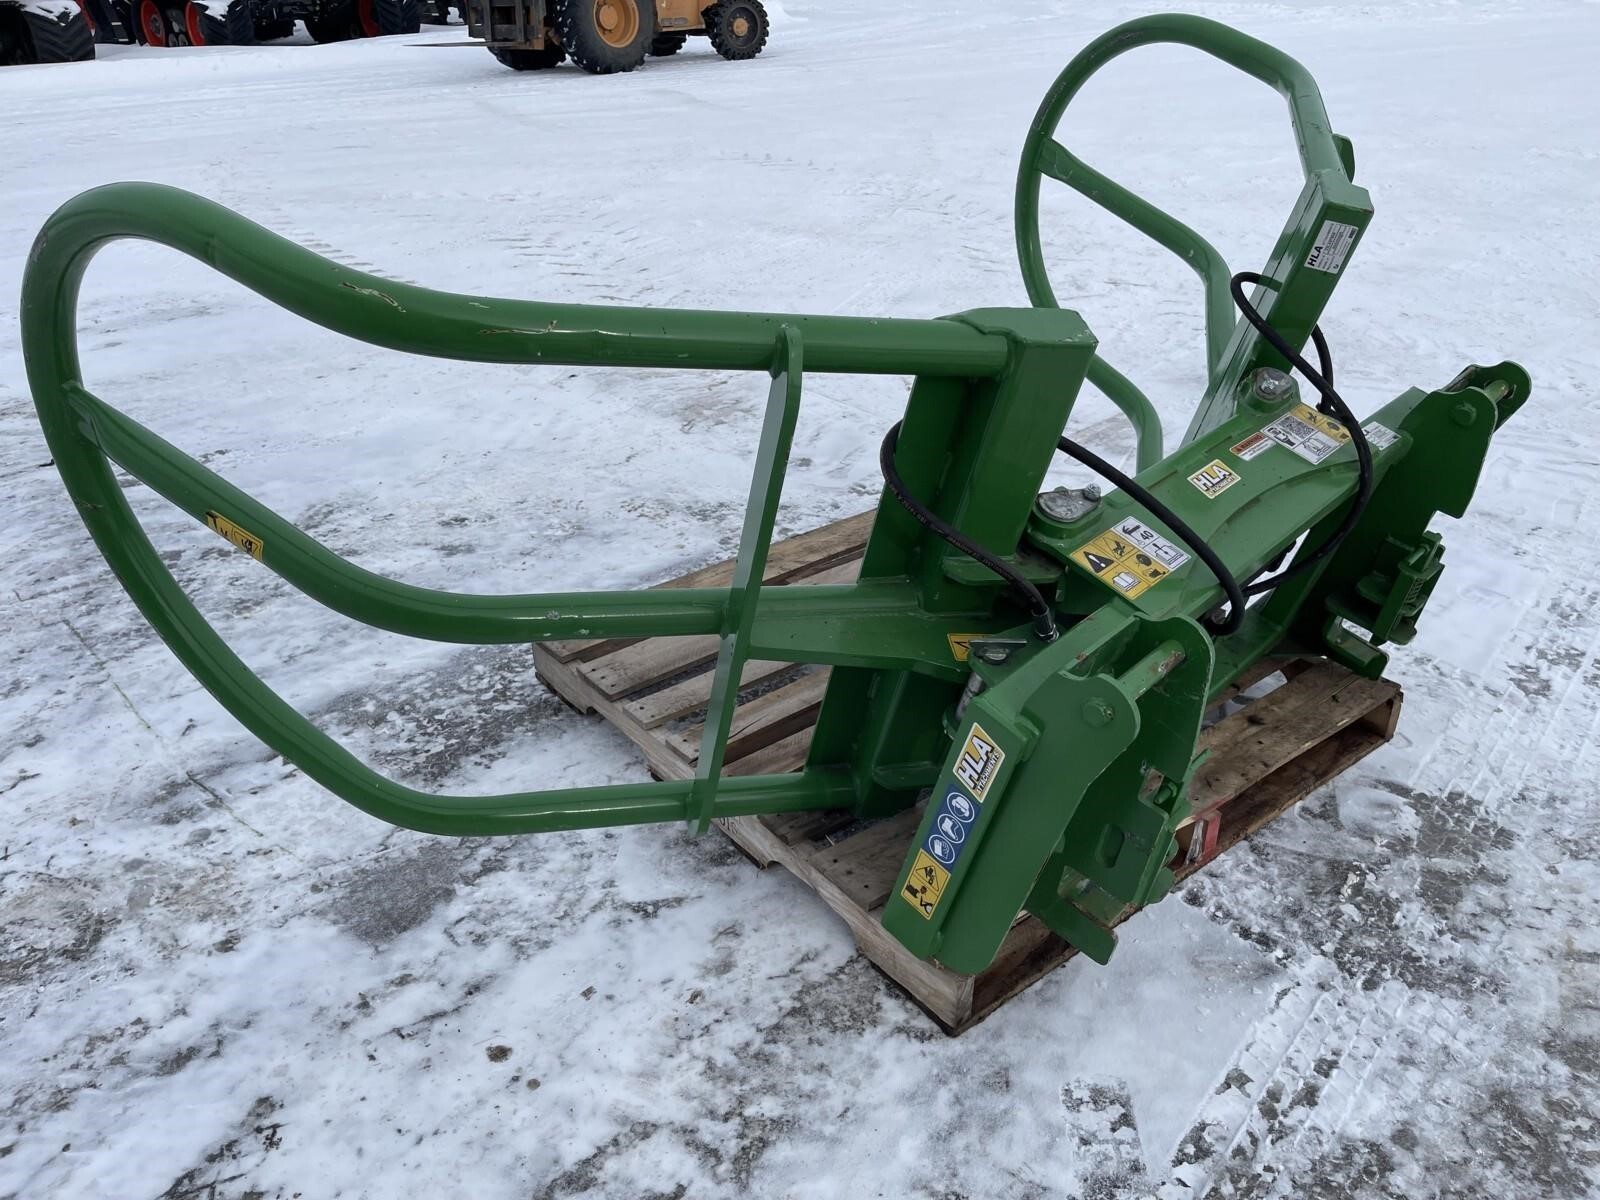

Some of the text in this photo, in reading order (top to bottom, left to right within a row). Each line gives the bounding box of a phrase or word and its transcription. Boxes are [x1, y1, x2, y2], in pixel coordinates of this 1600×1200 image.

[1307, 246, 1324, 267] HLA
[1192, 464, 1232, 492] HLA
[1140, 530, 1154, 541] 40
[957, 735, 994, 790] HLA
[976, 751, 1000, 794] ATTACHMENTS
